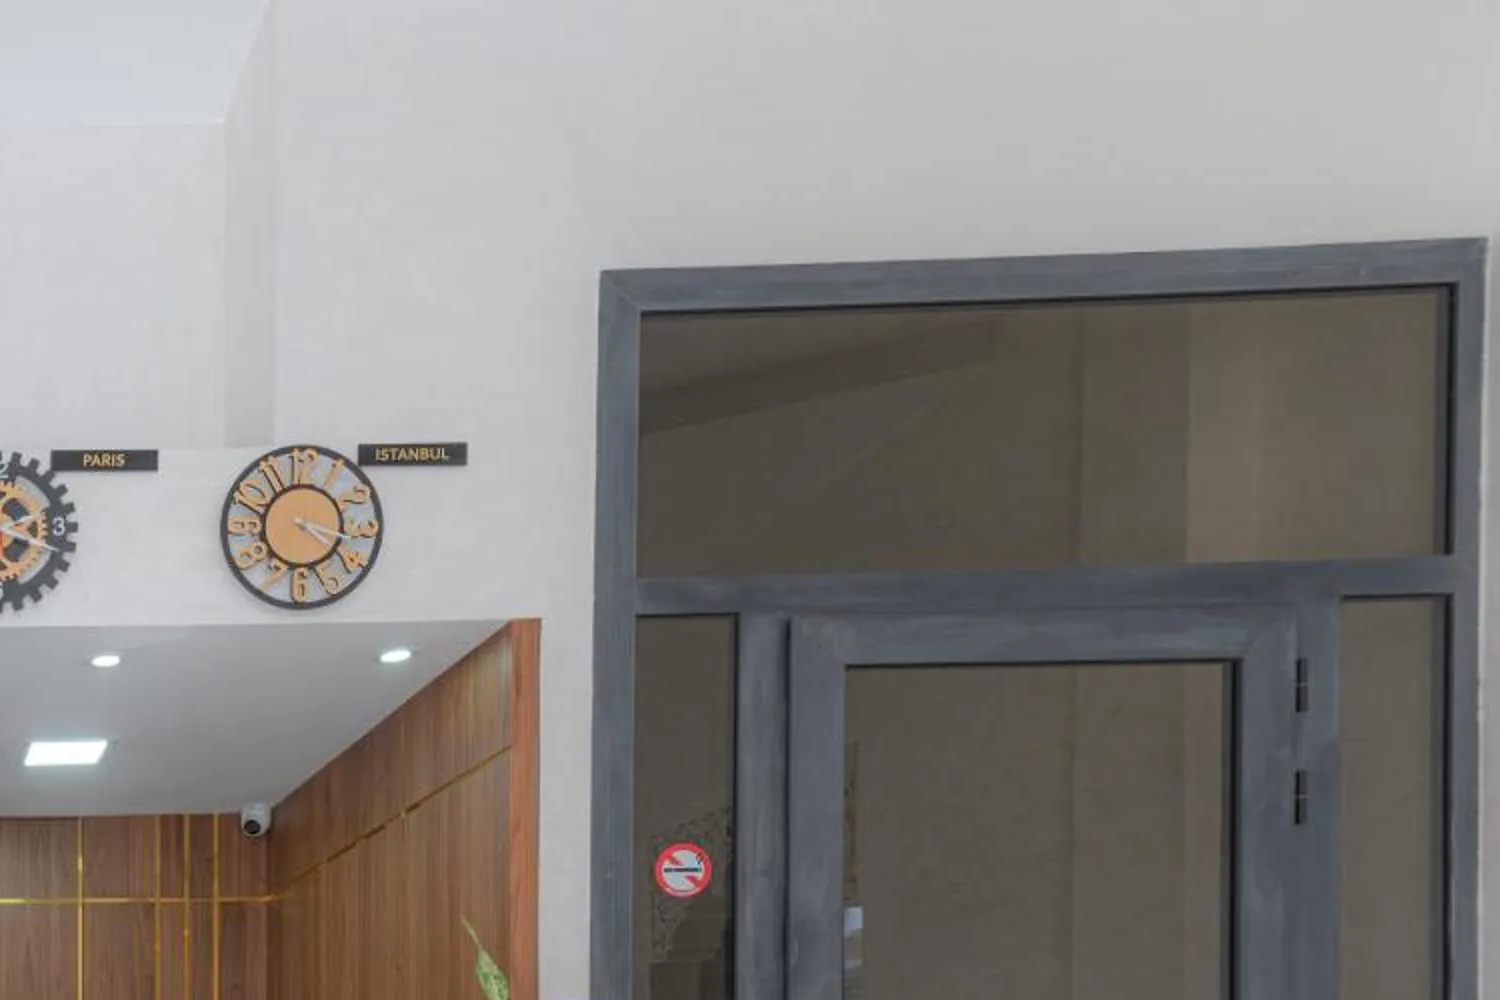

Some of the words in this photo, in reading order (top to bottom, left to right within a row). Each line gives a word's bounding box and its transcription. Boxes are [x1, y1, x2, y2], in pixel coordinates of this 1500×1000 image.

[83, 453, 126, 467] PARIS
[291, 448, 319, 486] 12
[375, 447, 450, 462] ISTANBUL
[259, 456, 284, 493] 11
[323, 458, 345, 488] 1
[233, 480, 272, 515] 10
[338, 485, 371, 510] 2
[52, 517, 65, 537] 3
[228, 518, 262, 535] 9
[344, 518, 379, 538] 3
[235, 541, 267, 570] 8
[338, 547, 369, 573] 4
[260, 557, 288, 593] 7
[291, 567, 309, 602] 6
[315, 560, 340, 595] 5
